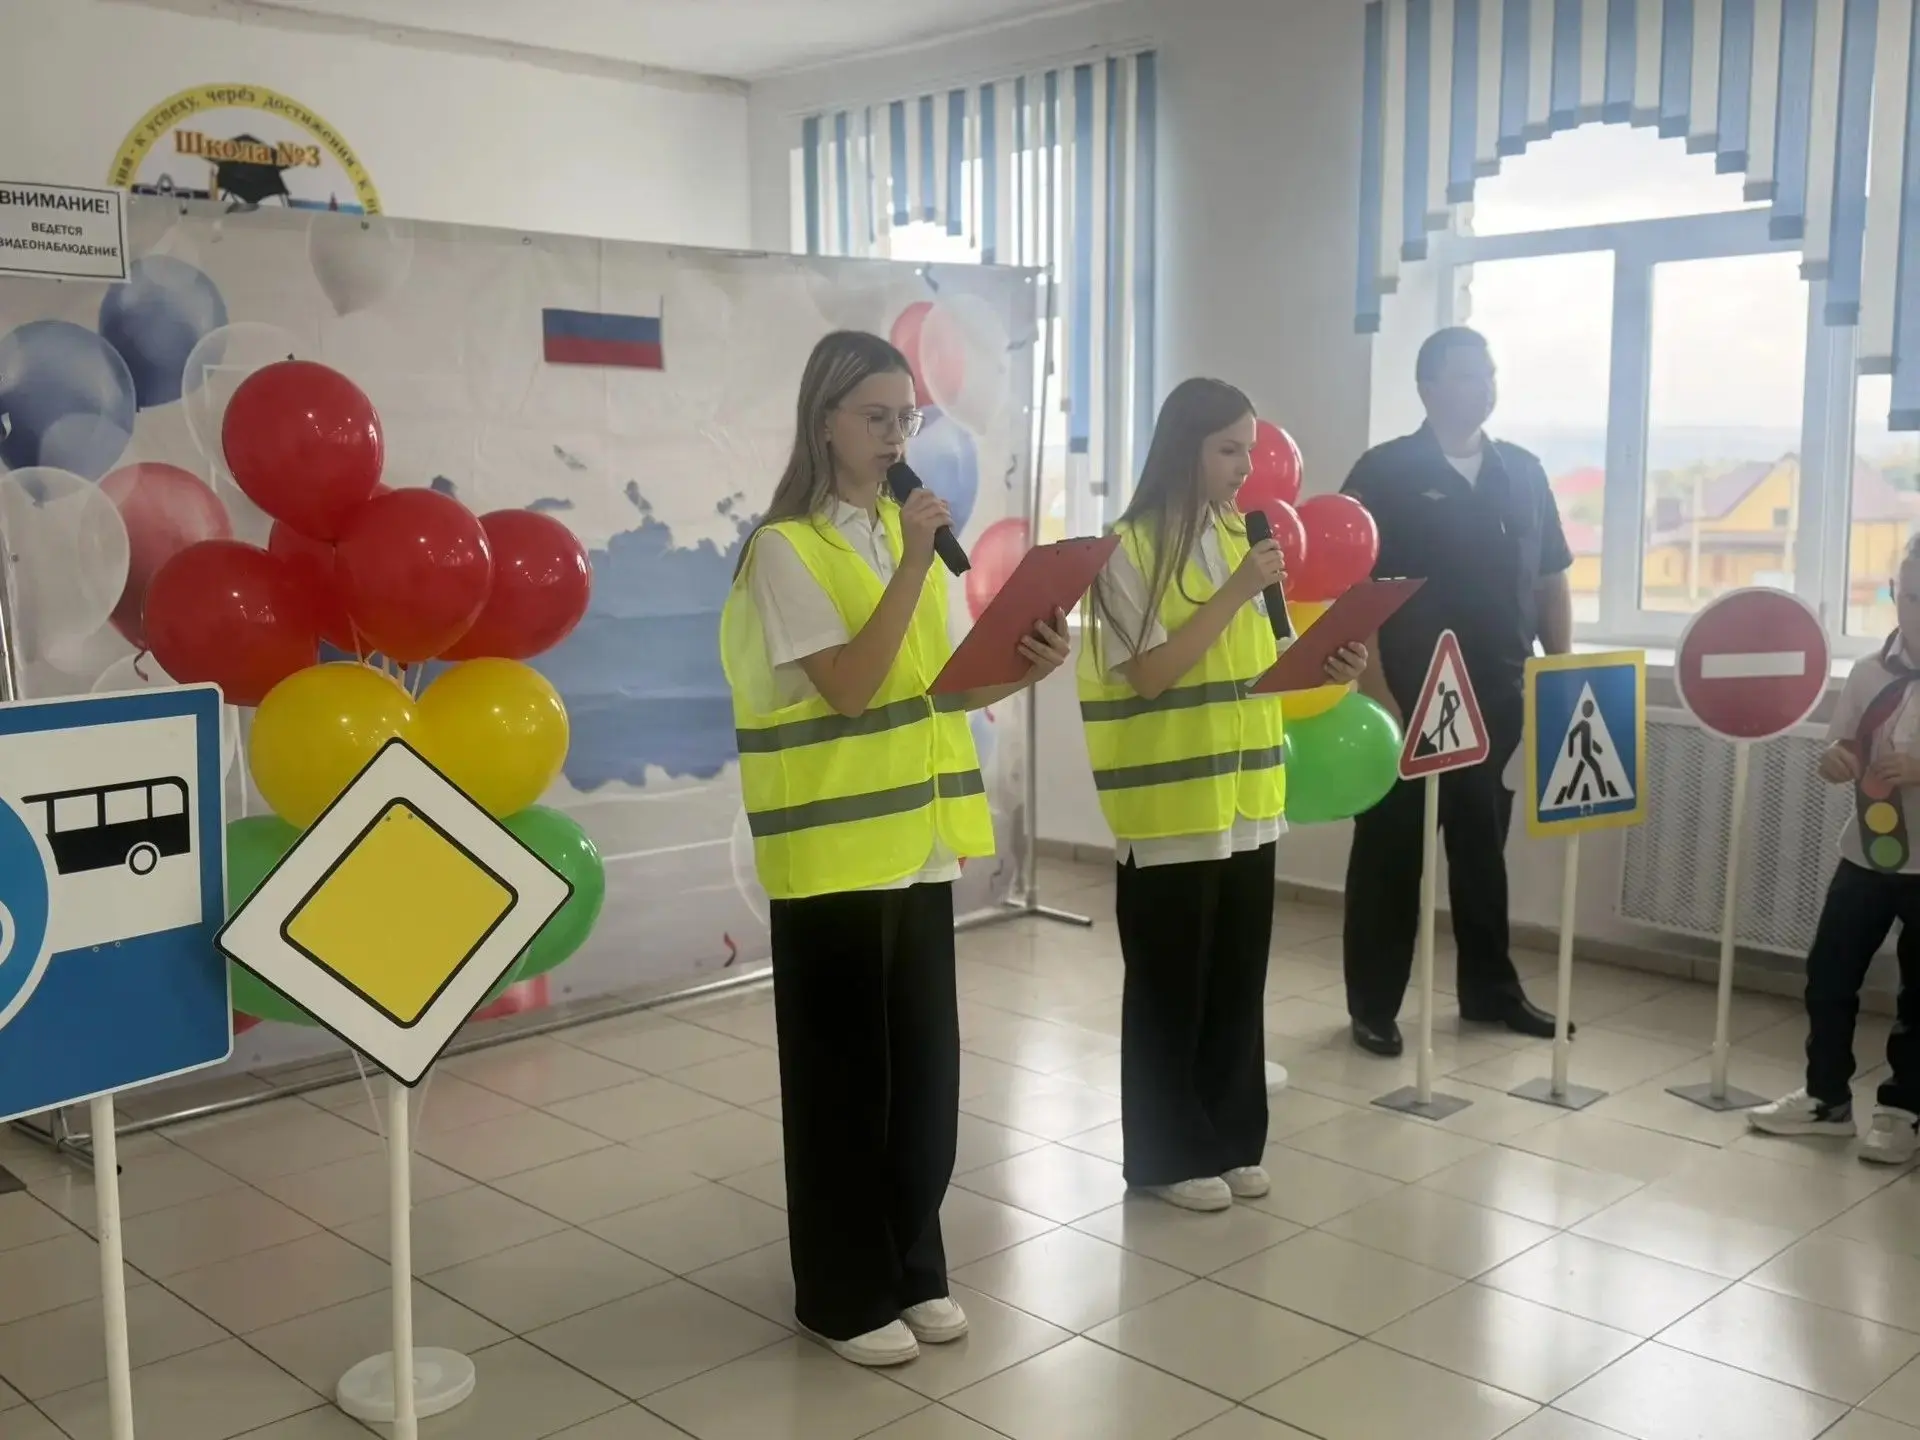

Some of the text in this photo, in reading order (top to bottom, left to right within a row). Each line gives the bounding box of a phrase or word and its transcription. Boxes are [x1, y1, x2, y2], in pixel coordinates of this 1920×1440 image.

[206, 86, 255, 104] через
[174, 130, 320, 168] Школа №3
[0, 189, 110, 214] ВНИМАНИЕ!
[31, 221, 83, 236] ВЕДЕТСЯ
